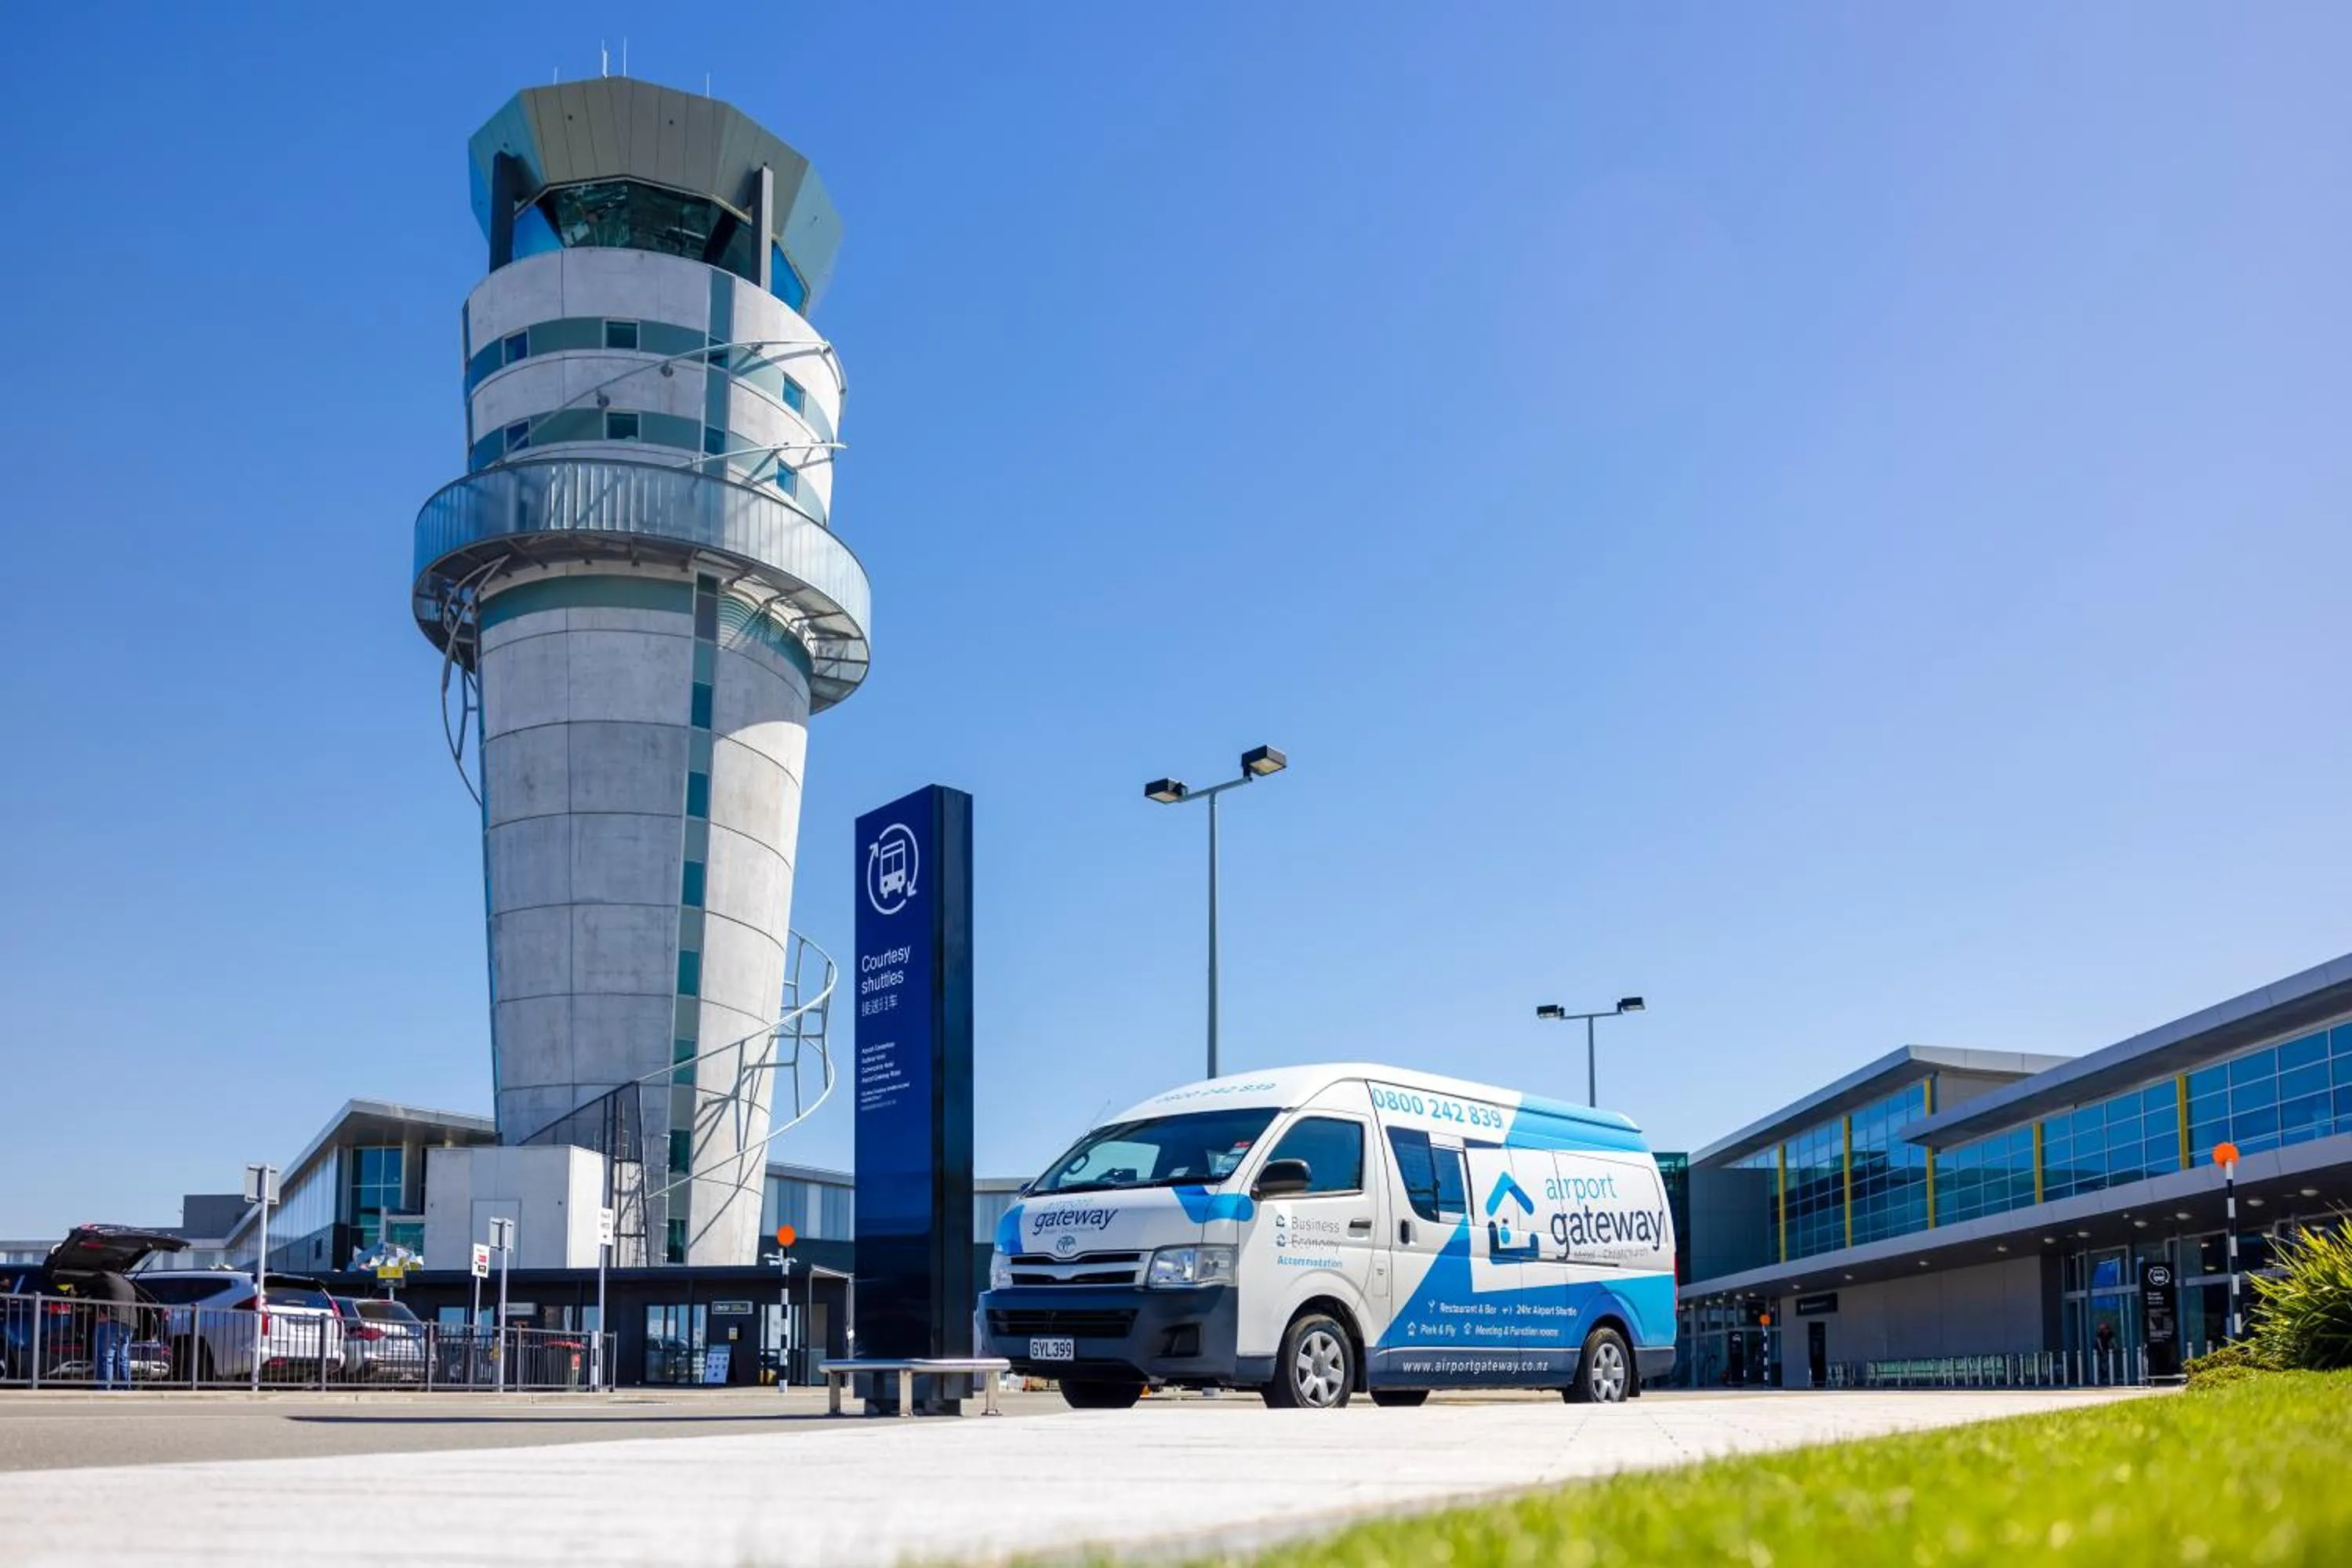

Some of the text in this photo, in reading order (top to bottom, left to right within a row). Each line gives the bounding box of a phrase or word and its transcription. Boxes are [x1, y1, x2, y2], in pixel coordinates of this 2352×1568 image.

[862, 946, 911, 972] Courtesy
[862, 970, 904, 995] shuttles
[1372, 1088, 1503, 1129] 0800 242 839
[1545, 1172, 1617, 1205] airport
[1032, 1208, 1119, 1236] gateway
[1291, 1216, 1340, 1233] Business
[1551, 1205, 1663, 1260] gateway
[1291, 1233, 1341, 1254] Economy
[1277, 1255, 1342, 1268] Accommodation
[1439, 1301, 1478, 1314] Restaurant
[1421, 1323, 1437, 1334] Park
[1031, 1341, 1072, 1357] GYL399
[1403, 1356, 1548, 1375] www.airportgateway.co.nz
